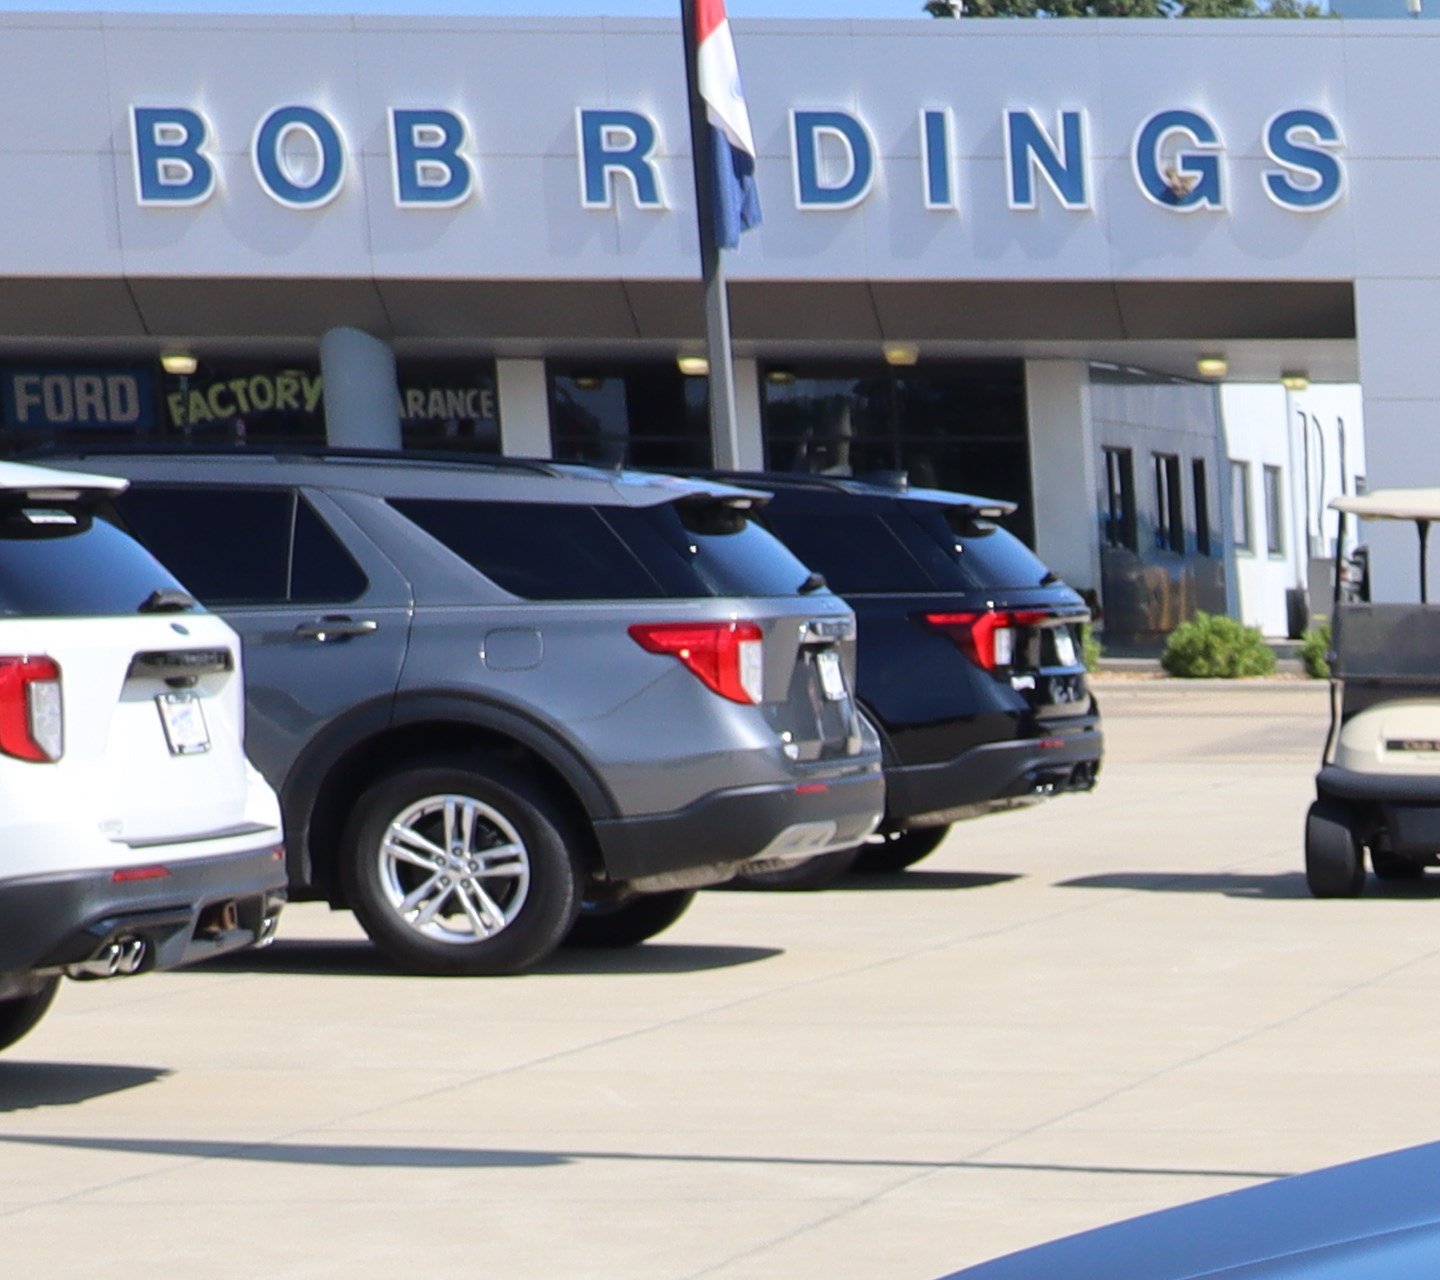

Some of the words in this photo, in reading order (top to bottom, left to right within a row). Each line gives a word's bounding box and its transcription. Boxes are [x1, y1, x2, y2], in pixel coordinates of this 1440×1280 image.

[129, 104, 477, 211] BOB
[577, 105, 1346, 213] RDINGS
[12, 374, 141, 423] FORD
[166, 374, 323, 428] FACTORY
